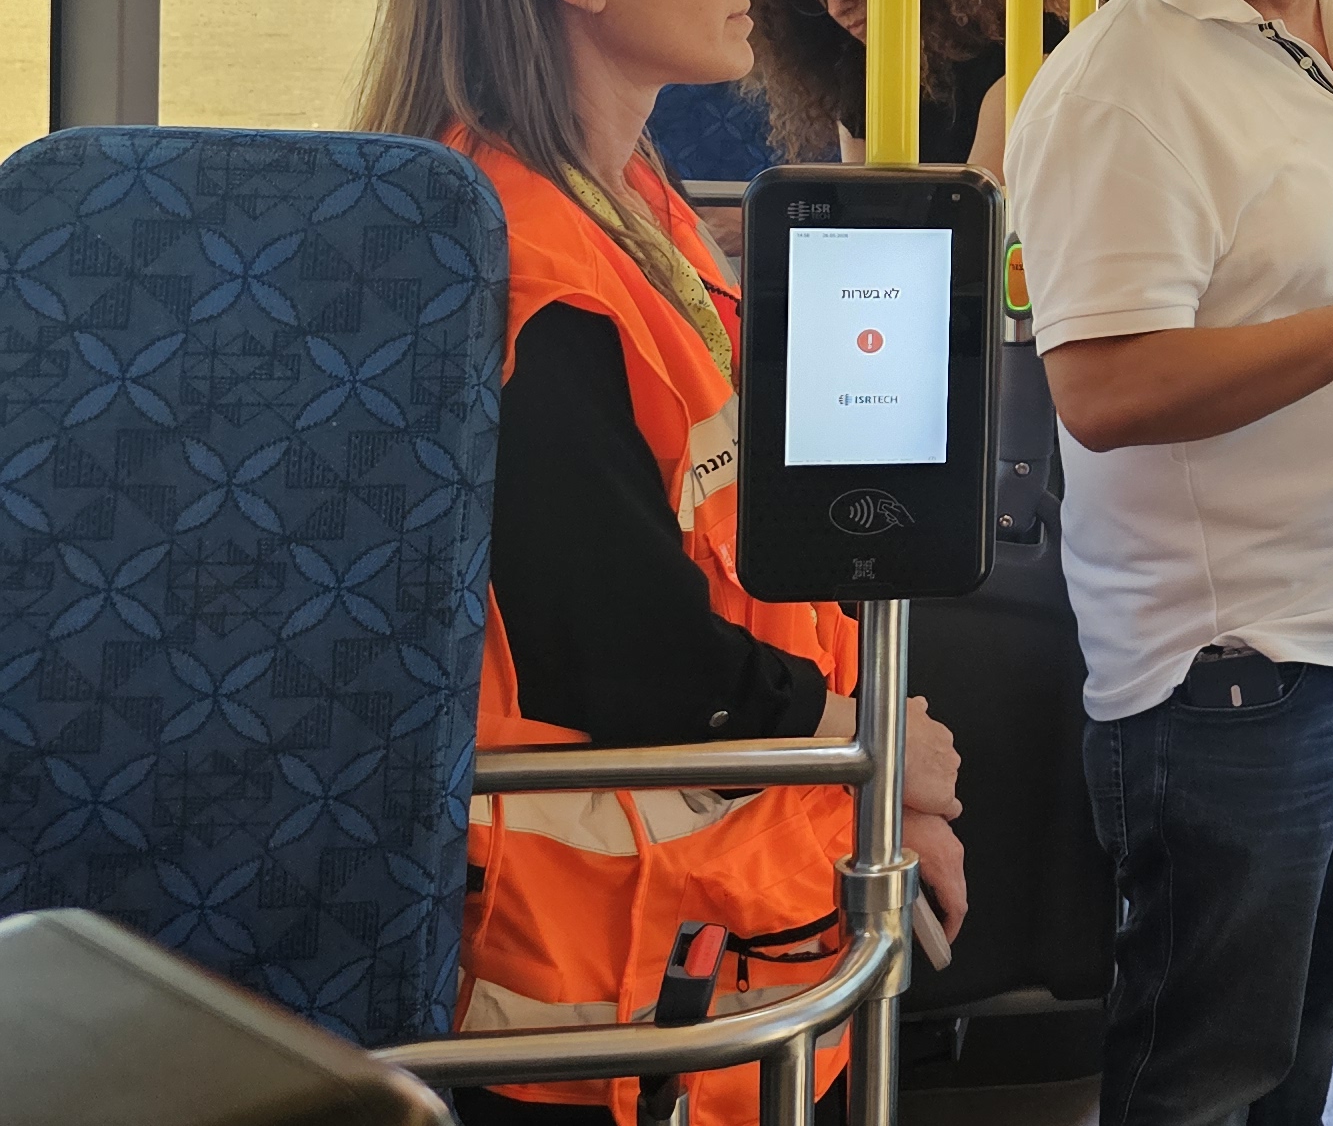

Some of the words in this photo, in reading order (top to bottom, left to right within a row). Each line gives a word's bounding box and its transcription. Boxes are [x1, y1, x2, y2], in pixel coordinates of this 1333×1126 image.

[811, 203, 831, 213] ISR
[841, 289, 881, 299] בשרות
[883, 287, 900, 299] לא
[854, 395, 898, 404] ISRTECH
